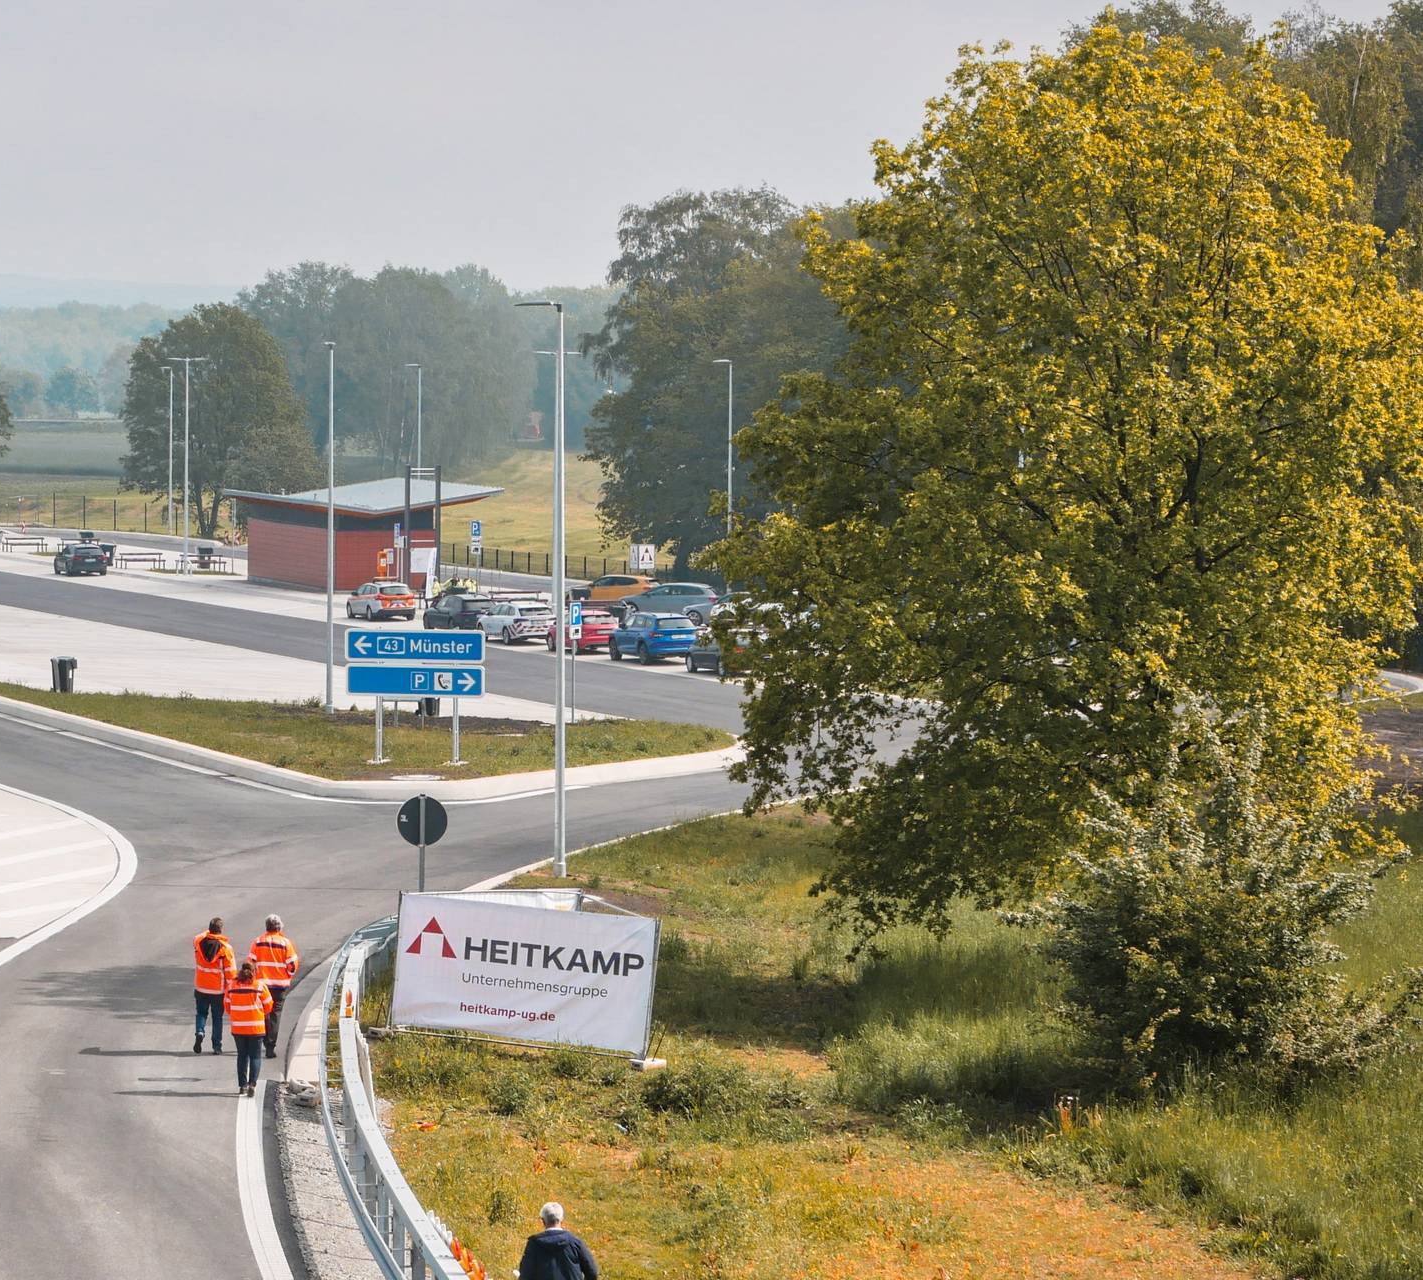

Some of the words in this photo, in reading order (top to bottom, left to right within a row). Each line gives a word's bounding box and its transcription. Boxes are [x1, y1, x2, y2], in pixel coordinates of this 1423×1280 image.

[572, 605, 579, 624] P
[384, 640, 398, 651] 43
[409, 639, 473, 654] Münster
[414, 674, 425, 688] P
[463, 936, 644, 977] HEITKAMP
[461, 972, 608, 998] Unternehmensgruppe
[459, 1001, 556, 1022] heitkamp-ug.de
